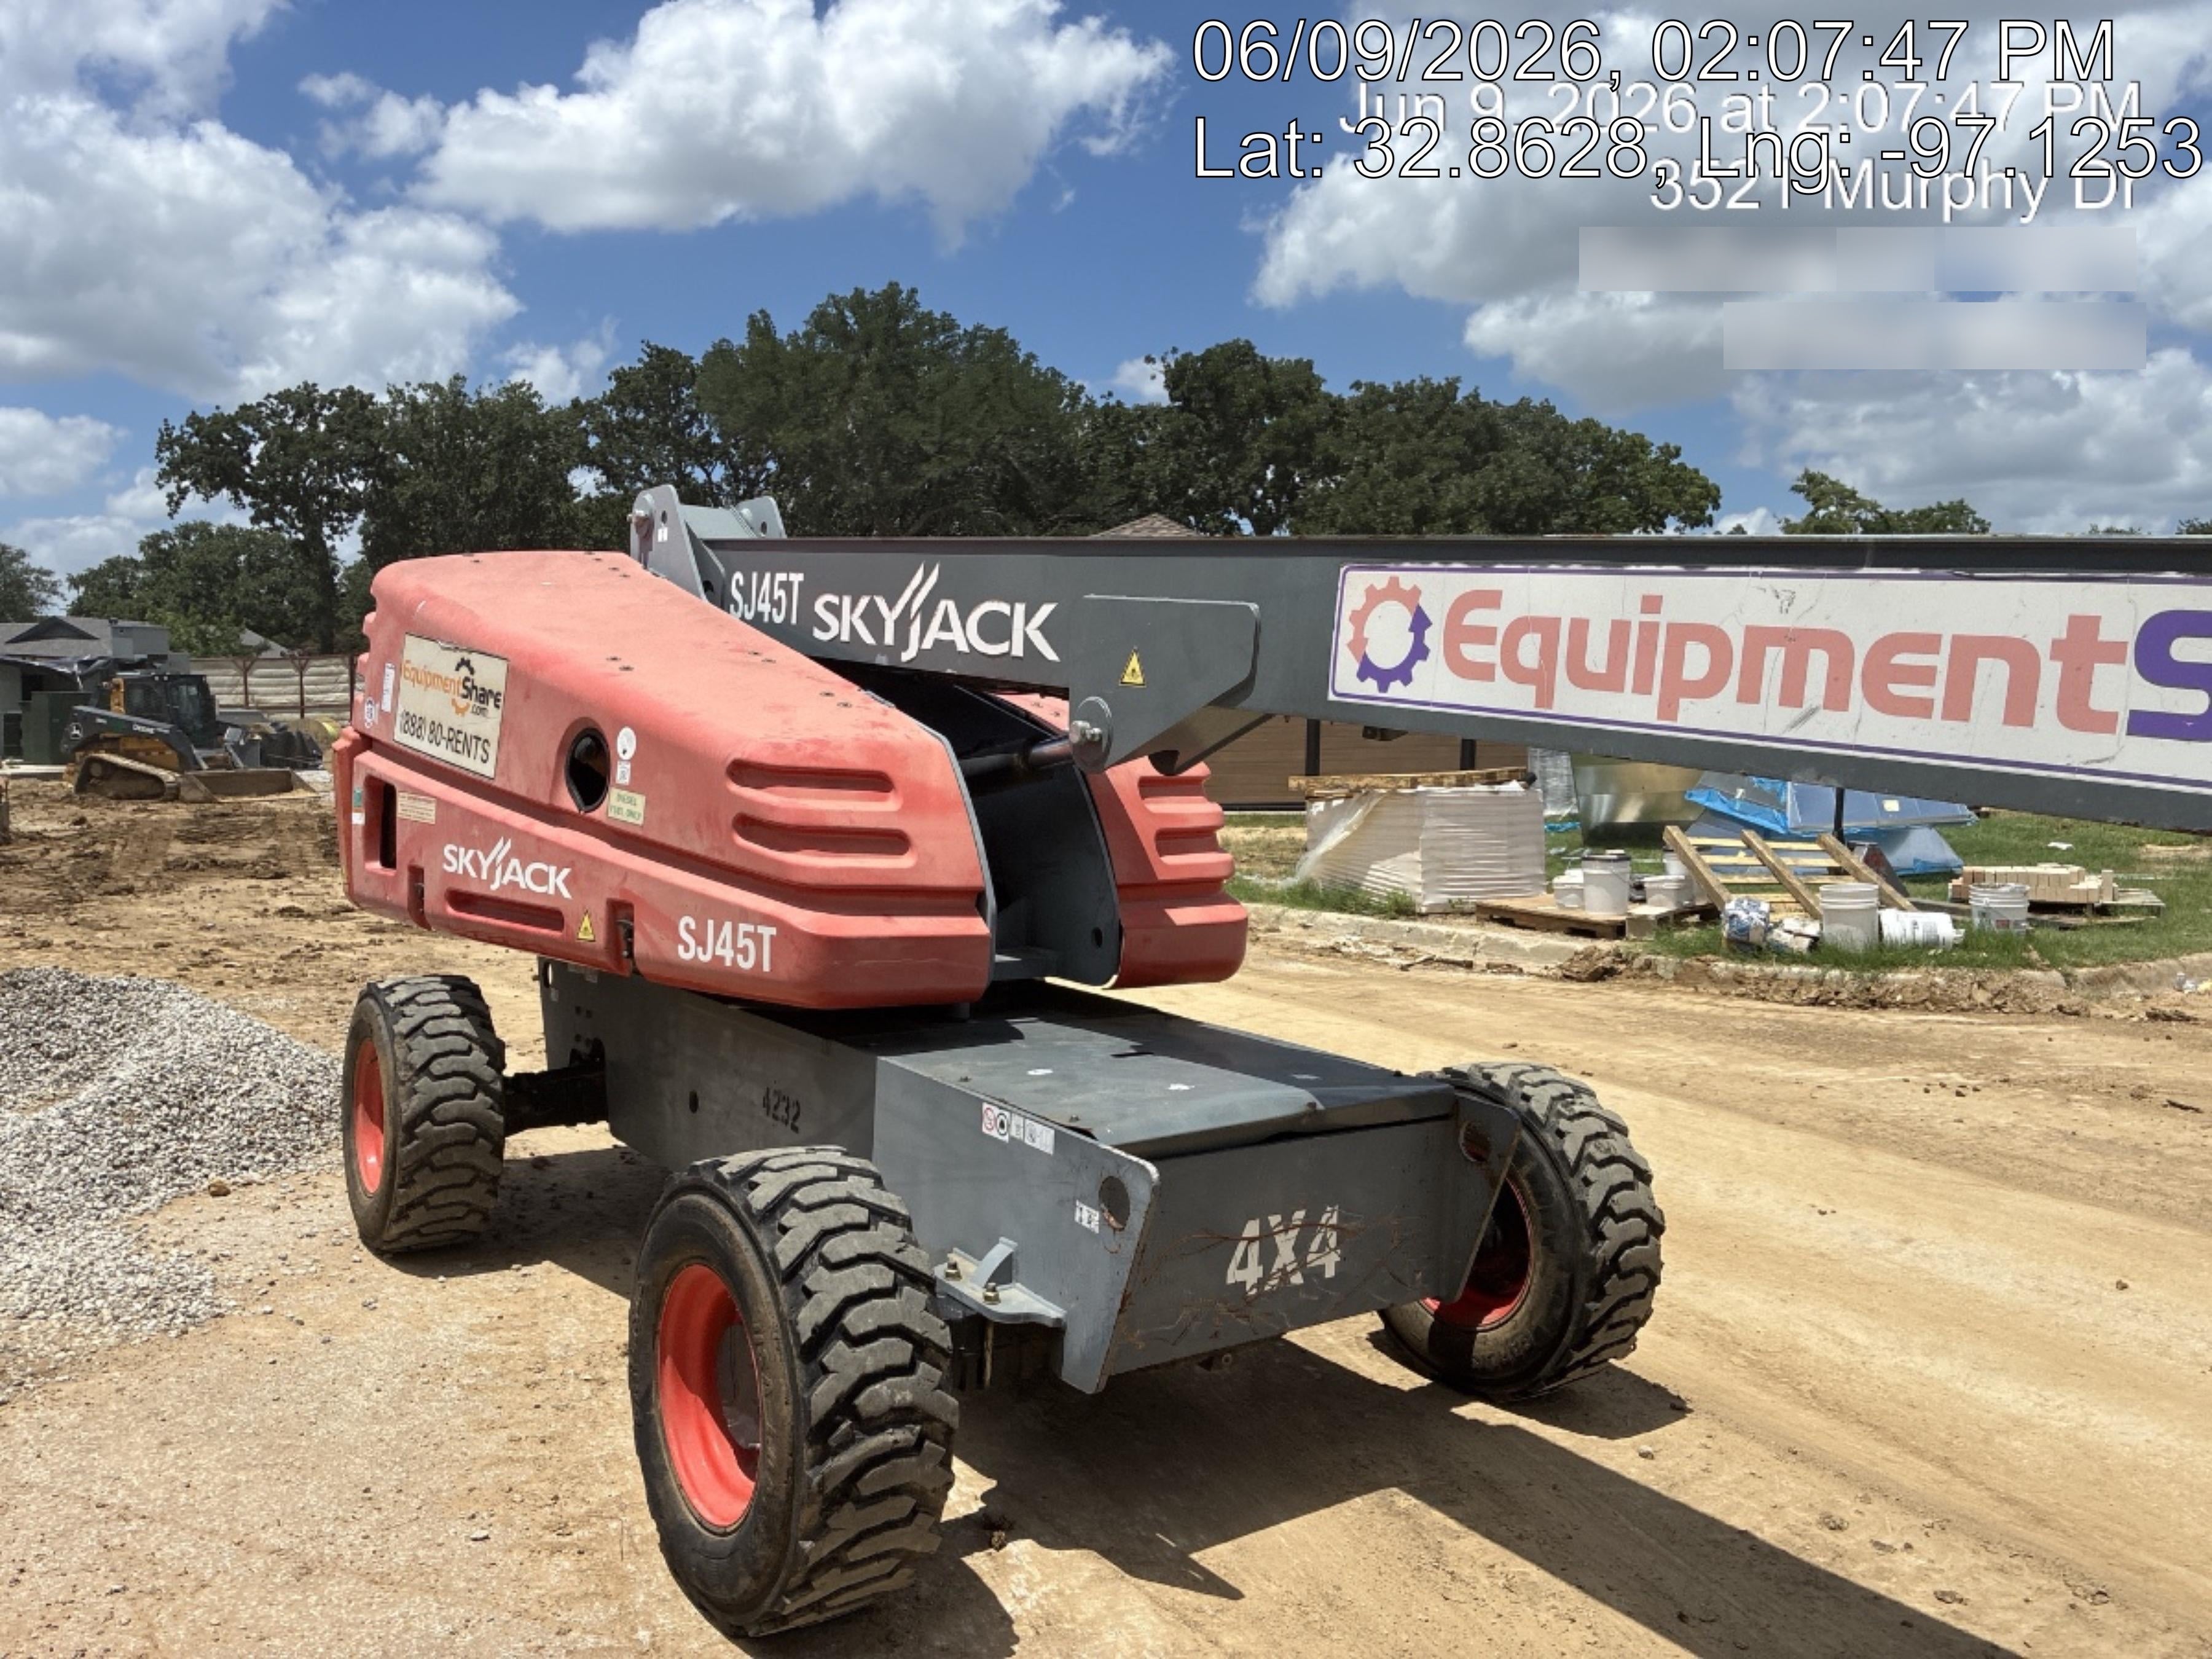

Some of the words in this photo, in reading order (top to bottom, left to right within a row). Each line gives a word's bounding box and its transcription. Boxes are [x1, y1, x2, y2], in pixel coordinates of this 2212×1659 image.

[730, 571, 804, 625] SJ45T
[812, 562, 1061, 663] SKYJACK
[402, 660, 503, 710] EquipmentShare
[399, 710, 426, 743] (888)
[428, 720, 491, 764] 80-RENTS
[442, 836, 573, 899] SKYJACK
[678, 916, 777, 972] SJ45T
[762, 1086, 801, 1134] 4232
[1226, 1204, 1341, 1295] 4X4
